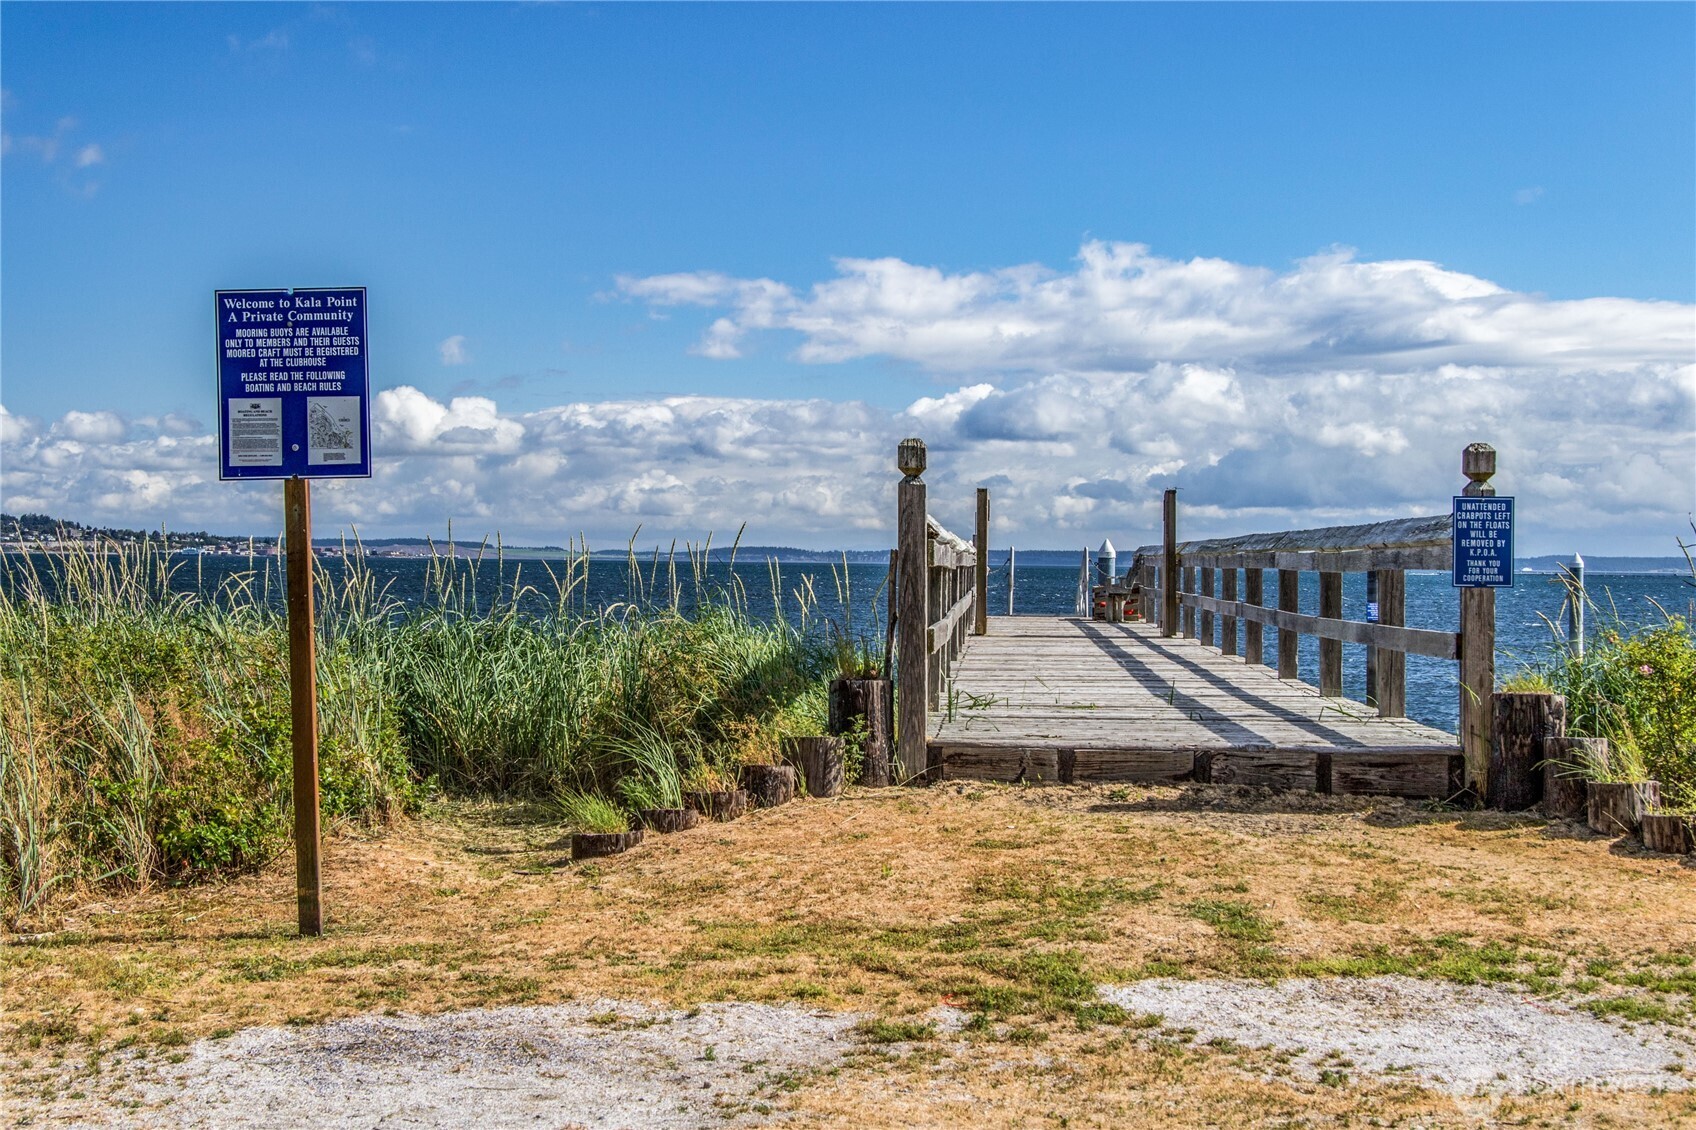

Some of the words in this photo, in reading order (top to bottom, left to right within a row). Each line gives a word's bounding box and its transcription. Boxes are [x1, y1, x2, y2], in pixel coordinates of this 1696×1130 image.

[224, 298, 274, 309] Welcome
[279, 298, 290, 308] to
[295, 297, 322, 307] Kala
[327, 297, 357, 307] Point
[228, 312, 237, 322] A
[242, 311, 284, 321] Private
[288, 310, 353, 321] Community
[236, 329, 267, 337] MOORING
[270, 328, 293, 336] BUOYS
[296, 328, 309, 336] ARE
[312, 327, 348, 335] AVAILABLE
[225, 339, 242, 347] ONLY
[256, 338, 290, 346] MEMBERS
[294, 338, 307, 346] AND
[310, 338, 330, 346] THEIR
[333, 337, 359, 345] GUESTS
[227, 349, 255, 357] MOORED
[258, 348, 280, 357] CRAFT
[283, 348, 302, 356] MUST
[305, 348, 314, 356] BE
[317, 347, 358, 356] REGISTERED
[260, 359, 268, 367] AT
[286, 358, 326, 366] CLUBHOUSE
[241, 373, 267, 381] PLEASE
[270, 372, 288, 381] READ
[290, 372, 303, 380] THE
[306, 371, 345, 380] FOLLOWING
[245, 384, 274, 392] BOATING
[277, 383, 291, 392] AND
[294, 383, 316, 391] BEACH
[319, 382, 342, 390] RULES
